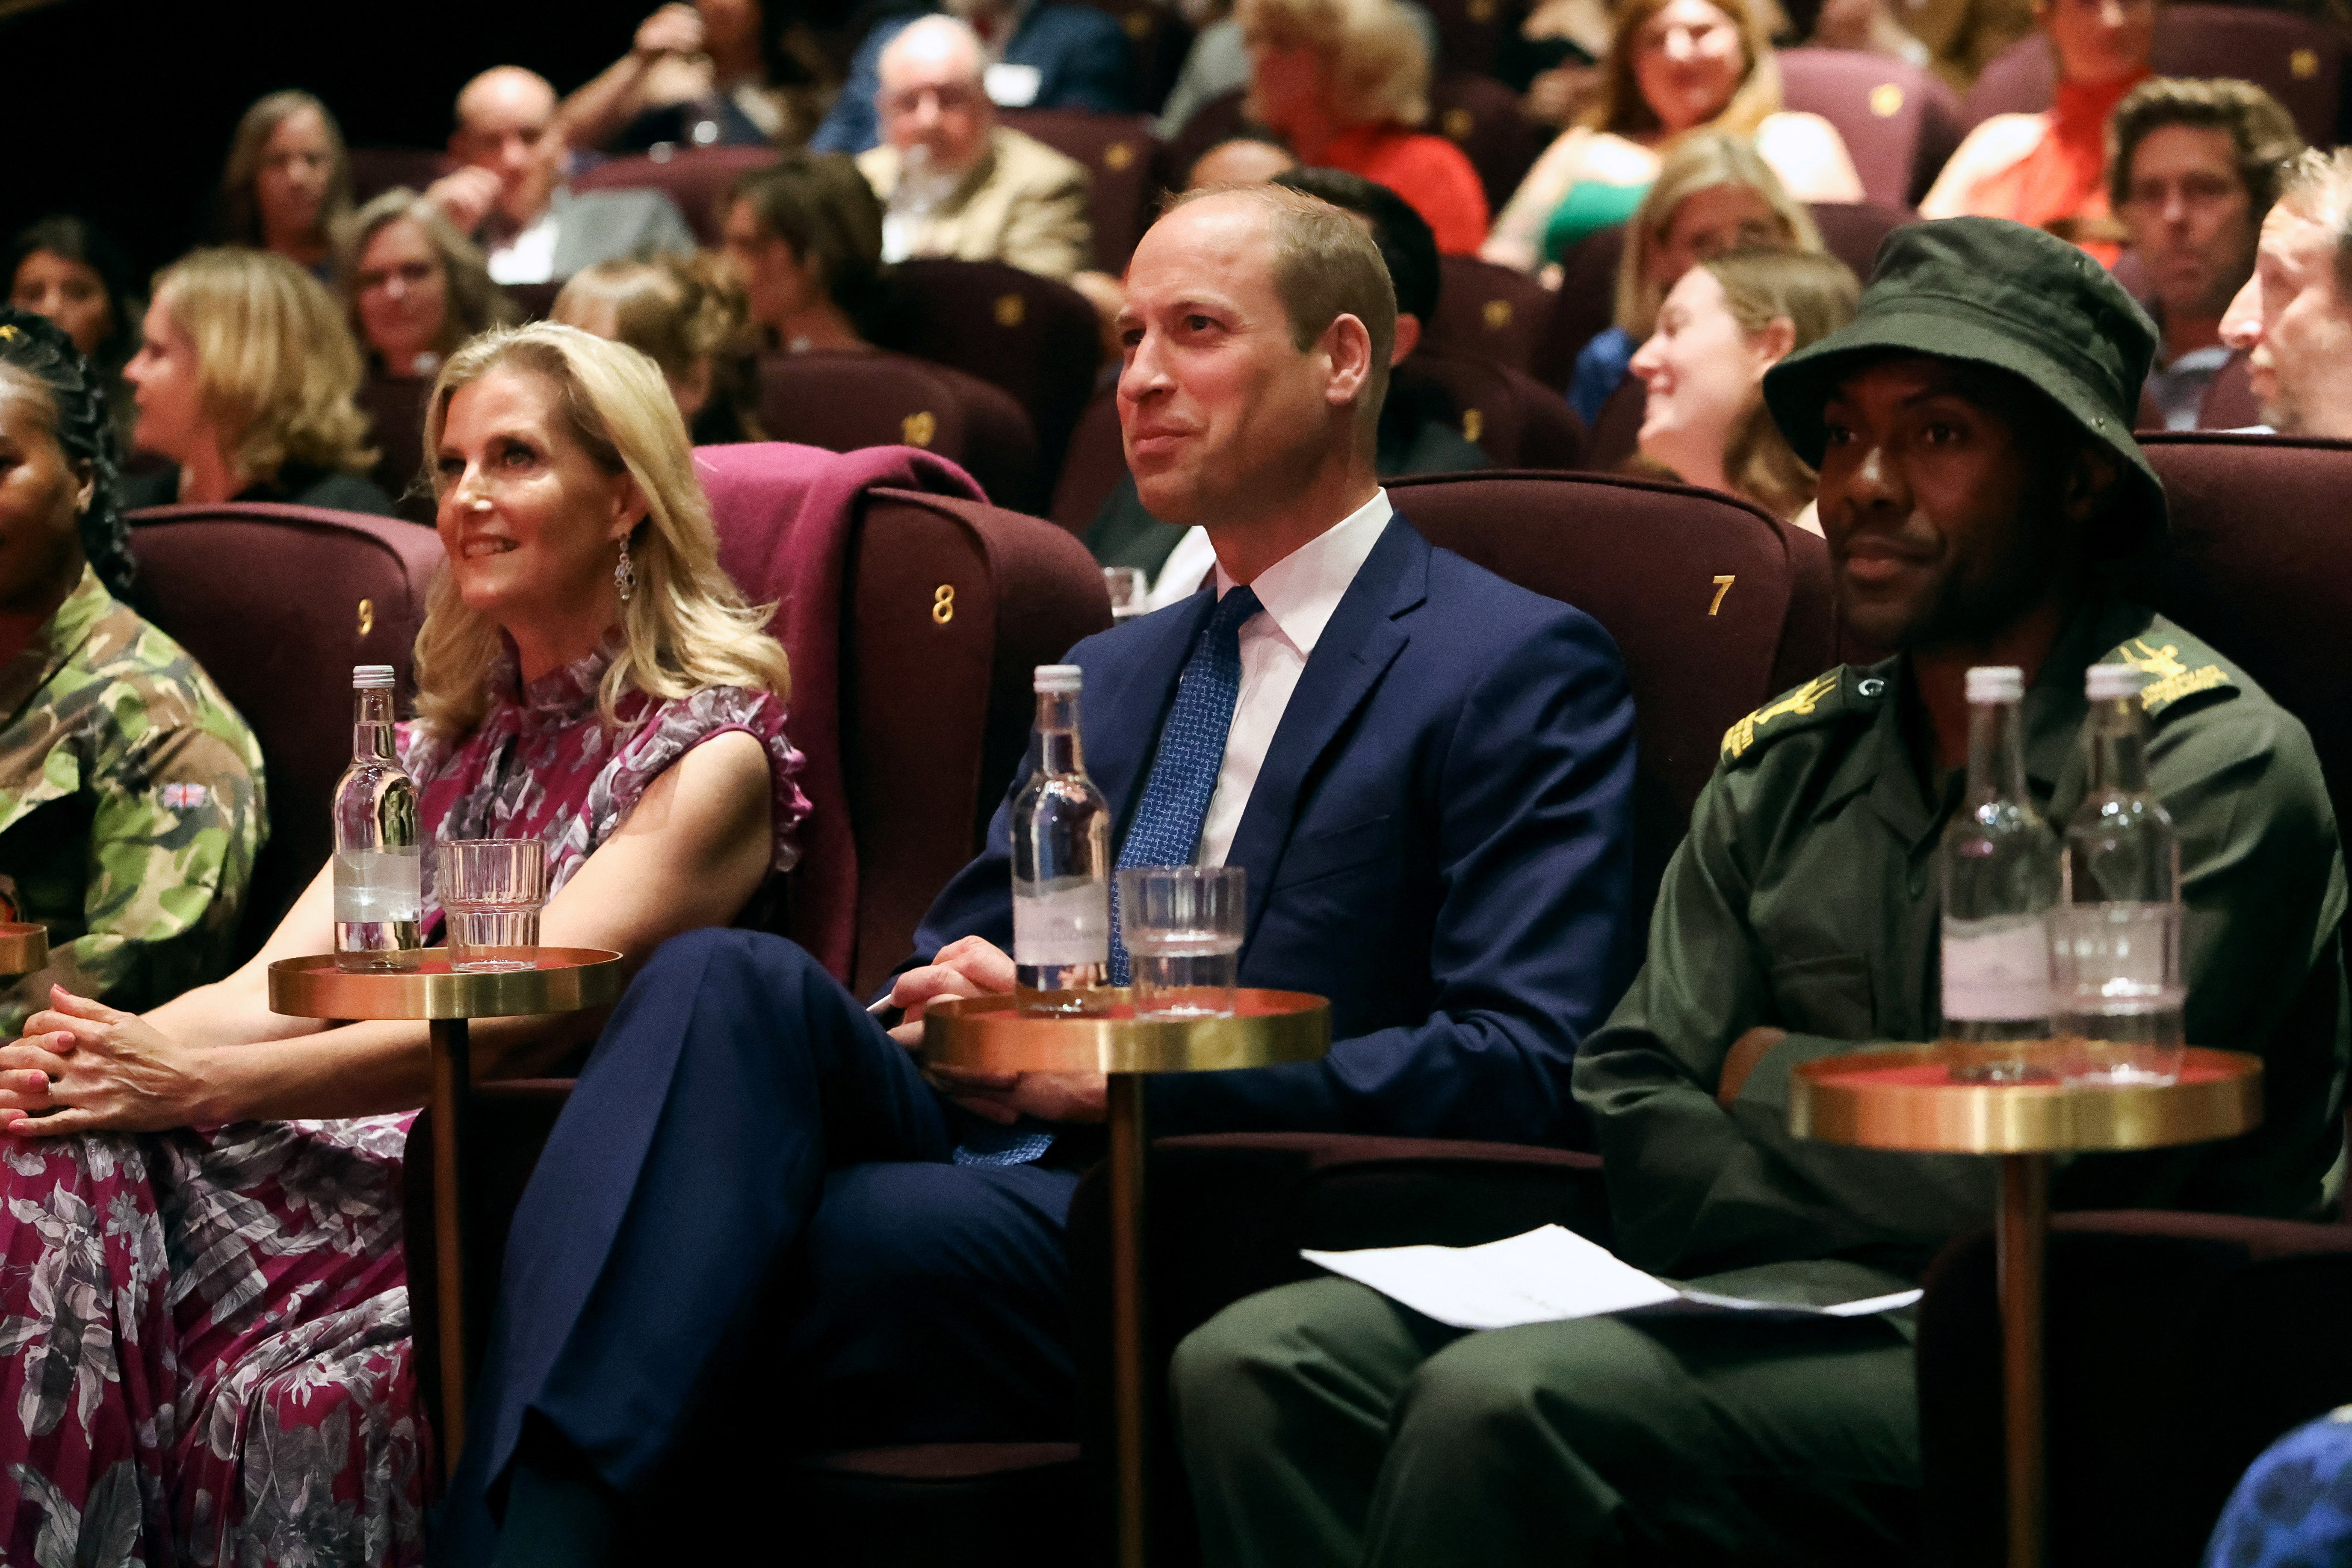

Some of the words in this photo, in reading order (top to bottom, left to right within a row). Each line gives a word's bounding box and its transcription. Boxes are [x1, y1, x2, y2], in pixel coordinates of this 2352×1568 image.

[933, 584, 954, 624] 8
[1708, 575, 1735, 615] 7
[357, 599, 373, 635] 9
